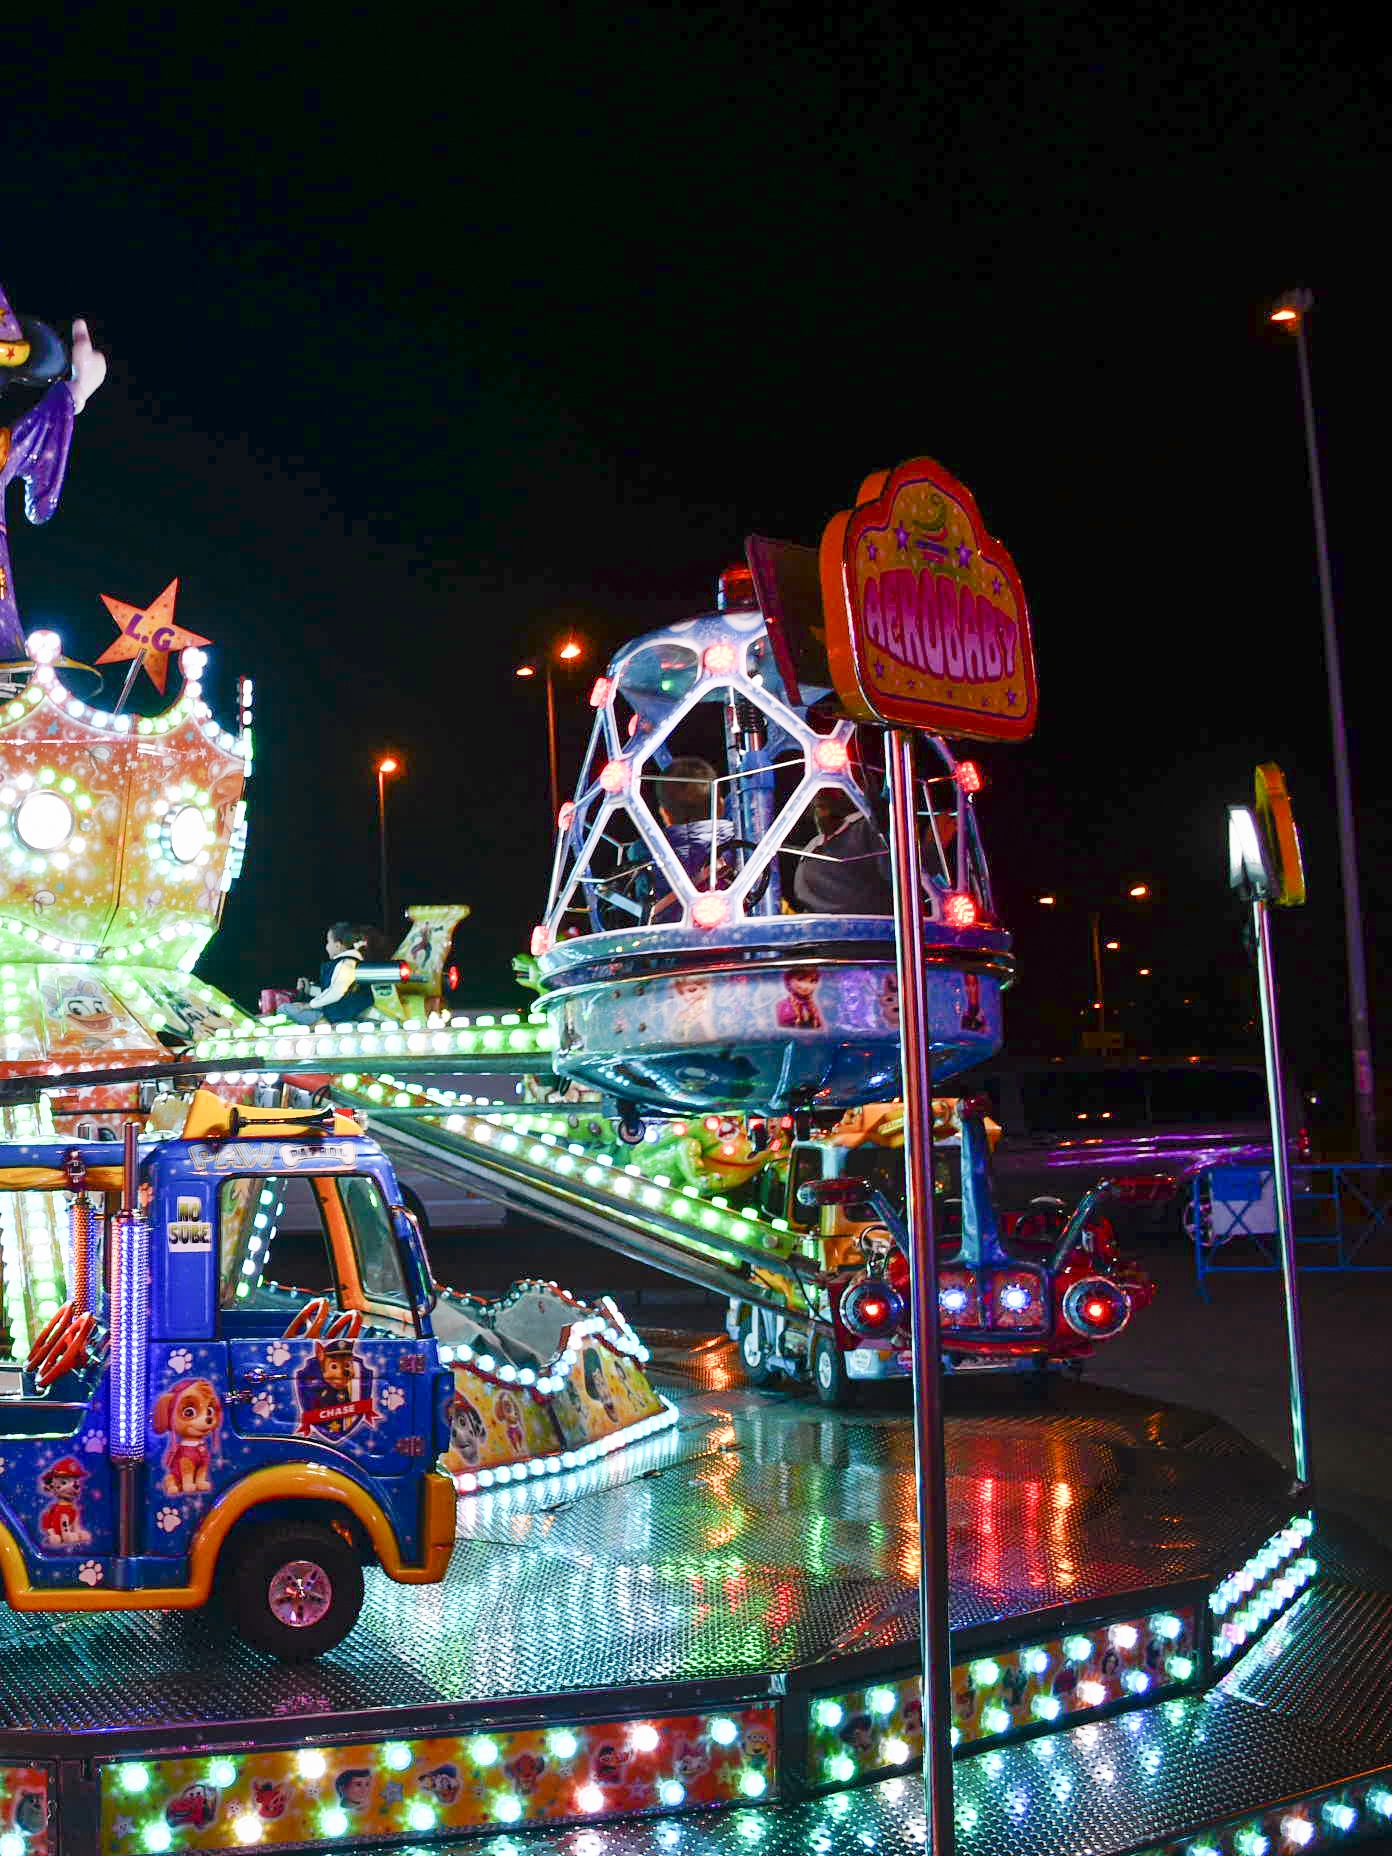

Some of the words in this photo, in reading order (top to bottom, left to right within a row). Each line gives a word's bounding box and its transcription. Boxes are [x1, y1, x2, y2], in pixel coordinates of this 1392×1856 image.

[864, 567, 1017, 684] AEROBABY
[188, 1142, 276, 1170] PAW
[178, 1203, 201, 1222] NO
[168, 1224, 210, 1244] SUBE
[319, 1405, 356, 1419] CHASE
